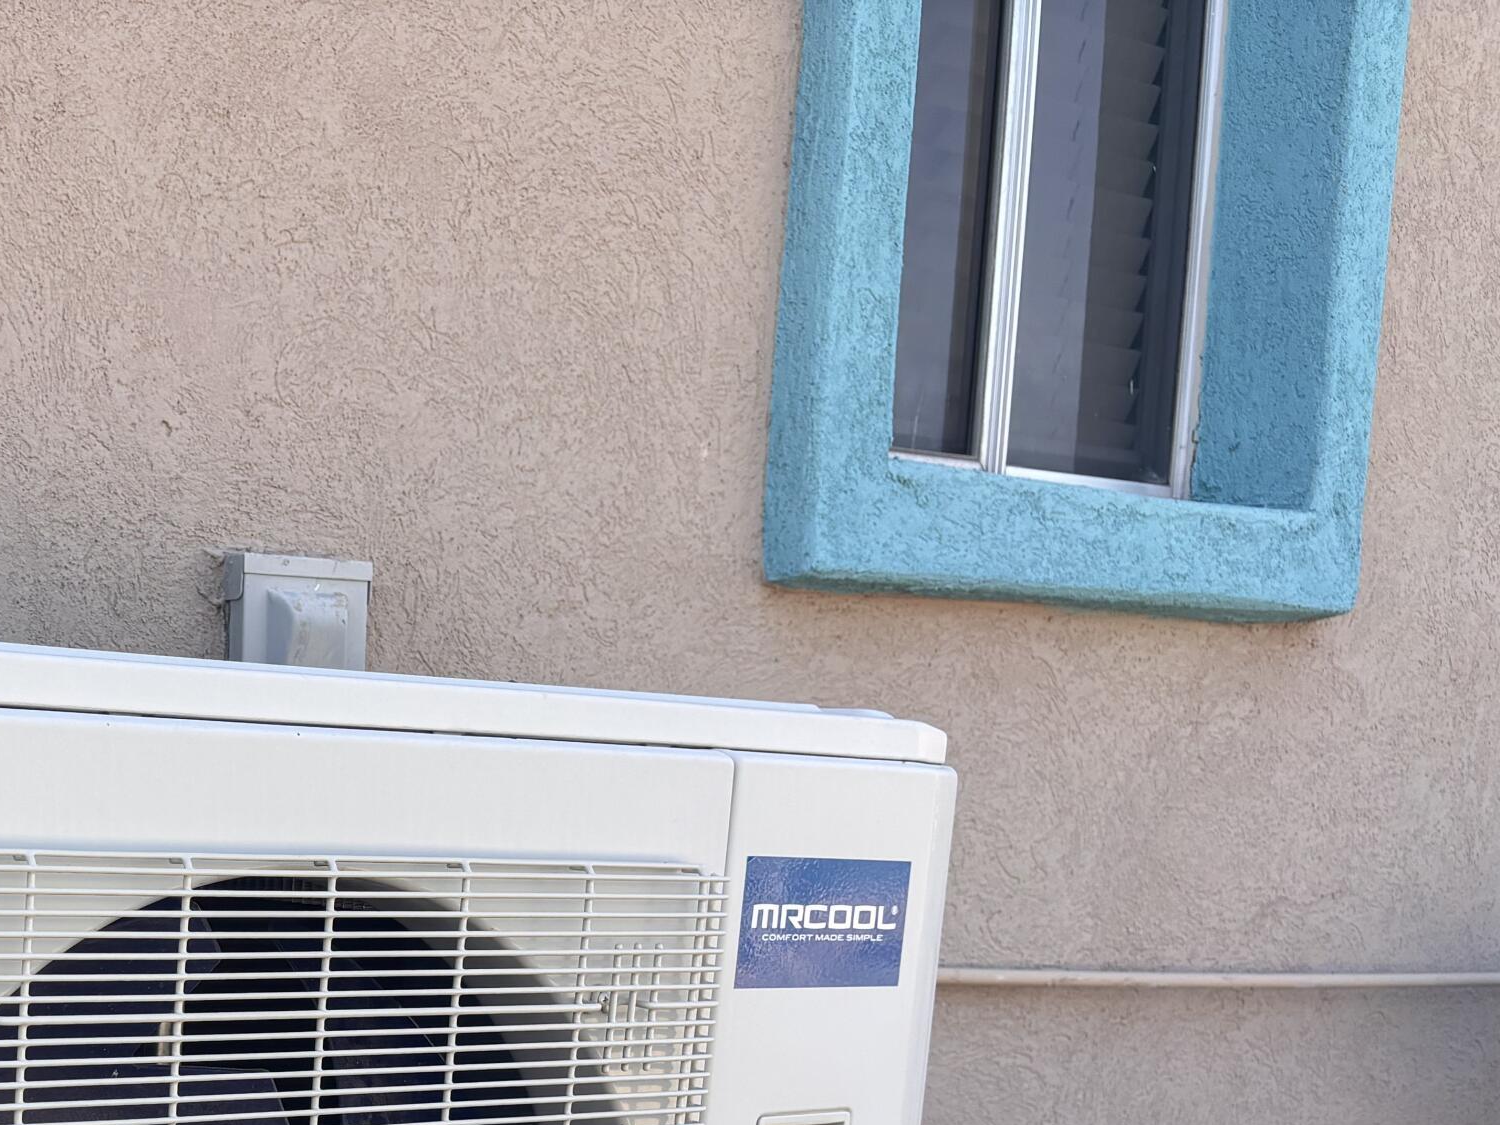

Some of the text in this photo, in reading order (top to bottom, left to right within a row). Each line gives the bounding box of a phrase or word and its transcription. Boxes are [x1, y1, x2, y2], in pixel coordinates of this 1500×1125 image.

[751, 903, 896, 930] MRCOOL
[761, 933, 884, 942] COMFORT MADE SIMPLE
